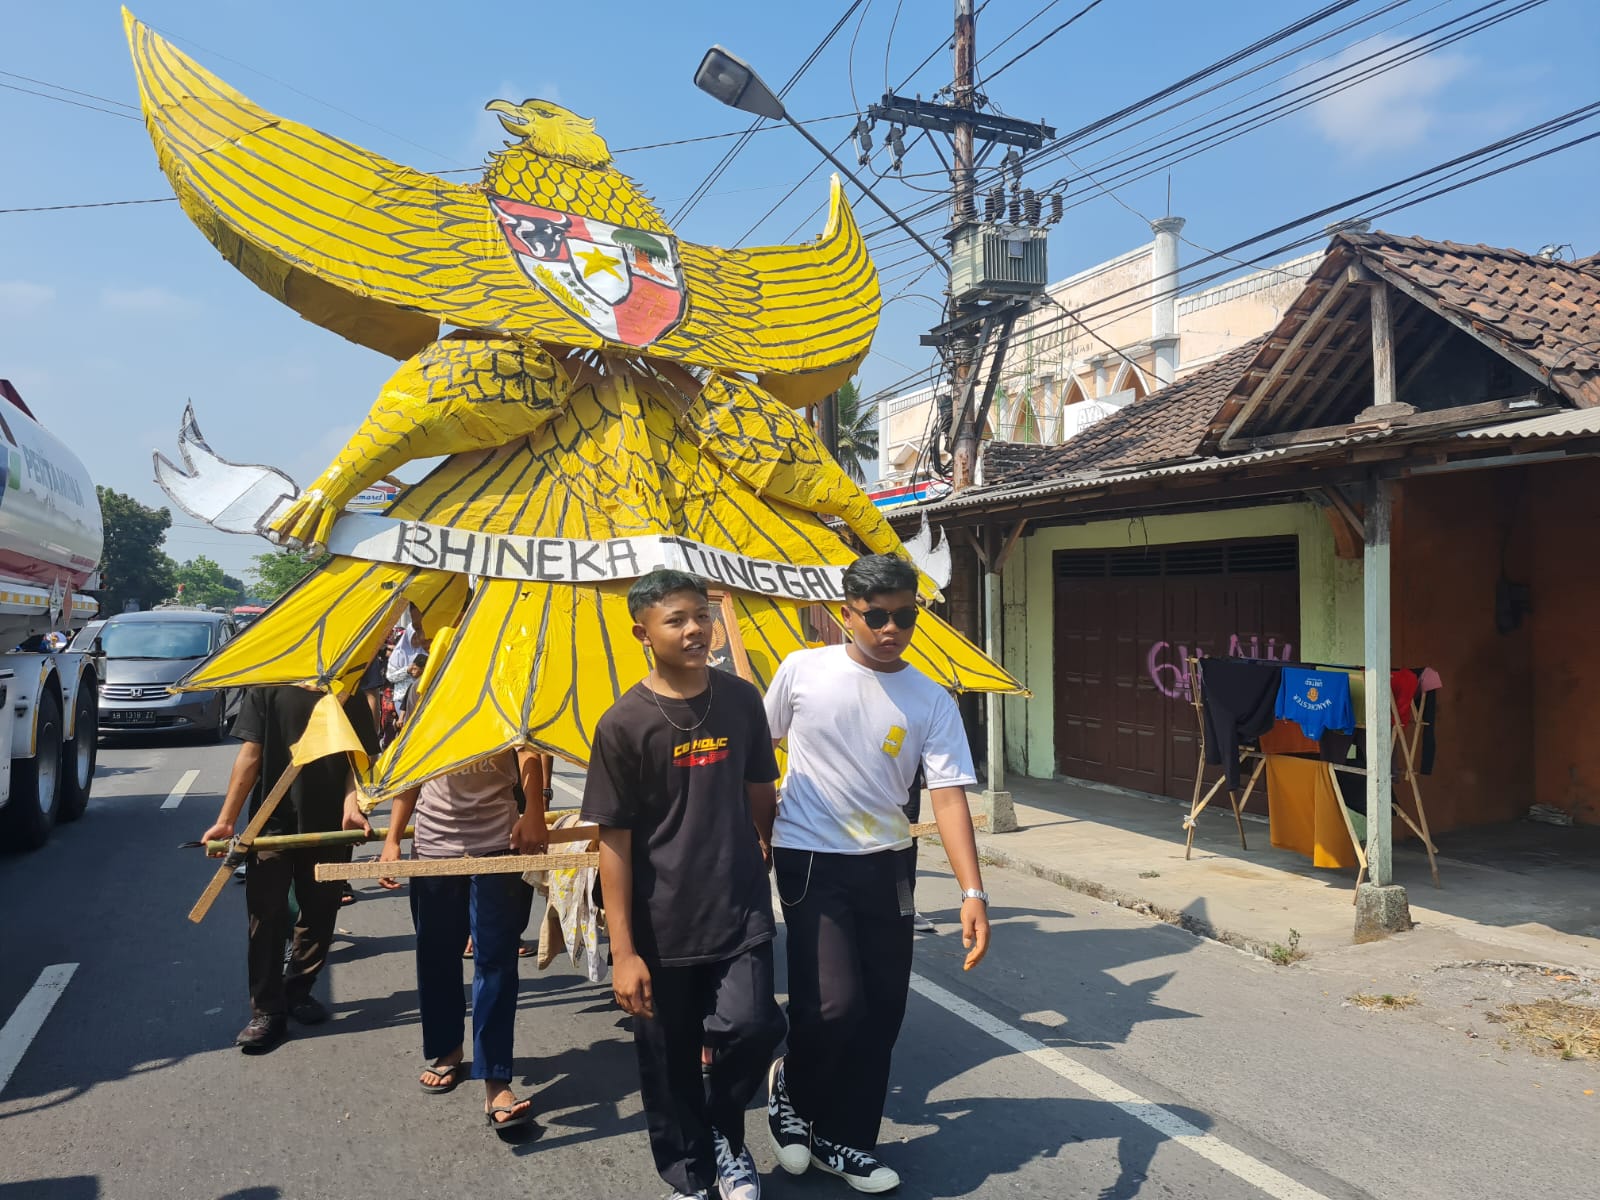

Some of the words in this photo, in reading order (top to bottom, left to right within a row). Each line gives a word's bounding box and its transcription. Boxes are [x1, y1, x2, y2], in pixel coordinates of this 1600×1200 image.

[392, 521, 642, 581] BHINEKA
[658, 536, 846, 600] TUNGGAL
[1292, 693, 1333, 711] MANCHESTER
